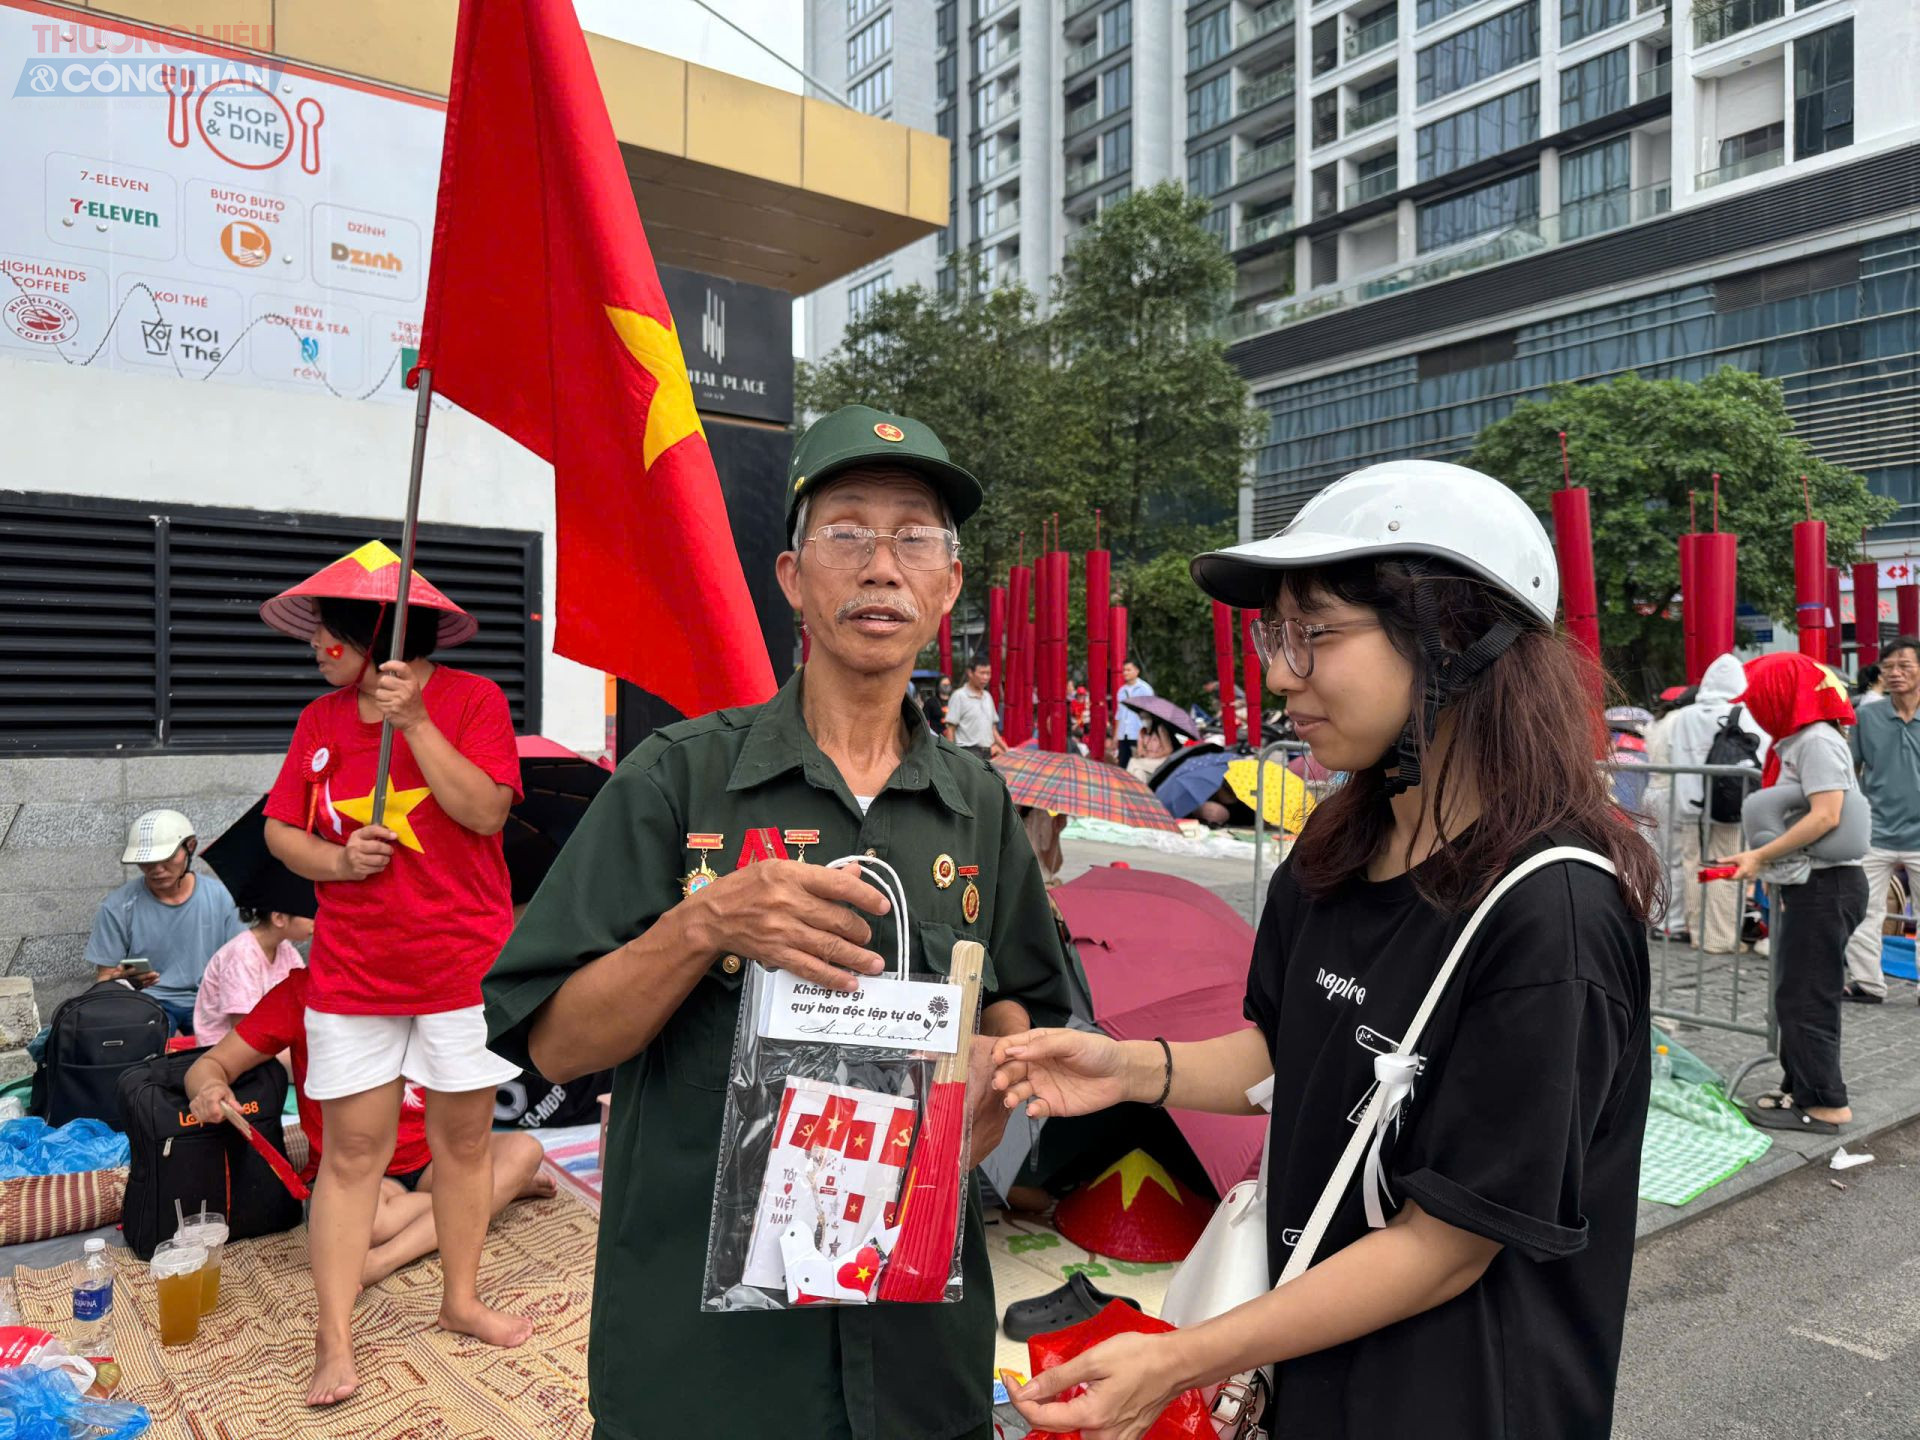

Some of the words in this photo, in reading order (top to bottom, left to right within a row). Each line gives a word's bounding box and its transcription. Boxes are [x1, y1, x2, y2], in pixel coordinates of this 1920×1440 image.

[213, 101, 278, 129] SHOP
[205, 119, 221, 137] &
[229, 124, 285, 150] DINE
[80, 170, 150, 192] 7-ELEVEN
[210, 188, 246, 204] BUTO
[250, 195, 285, 211] BUTO
[216, 203, 280, 223] NOODLES
[331, 242, 403, 272] Dzinh
[0, 260, 87, 282] HIGHLANDS
[12, 276, 70, 293] COFFEE
[154, 291, 178, 304] KOI
[8, 297, 75, 322] HIGHLANDS
[16, 326, 67, 342] COFFEE
[180, 325, 219, 344] KOI
[265, 315, 312, 330] COFFEE
[315, 322, 324, 331] &
[328, 323, 349, 334] TEA
[180, 343, 222, 362] Thé
[687, 369, 719, 388] ITAL
[722, 374, 767, 395] PLACE
[793, 984, 833, 999] Không
[791, 1002, 815, 1014] quý
[817, 1003, 839, 1014] hơn
[842, 1006, 865, 1018] độc
[867, 1008, 887, 1020] lập
[891, 1010, 905, 1022] tự
[906, 1011, 922, 1021] do
[770, 1212, 793, 1225] NAM
